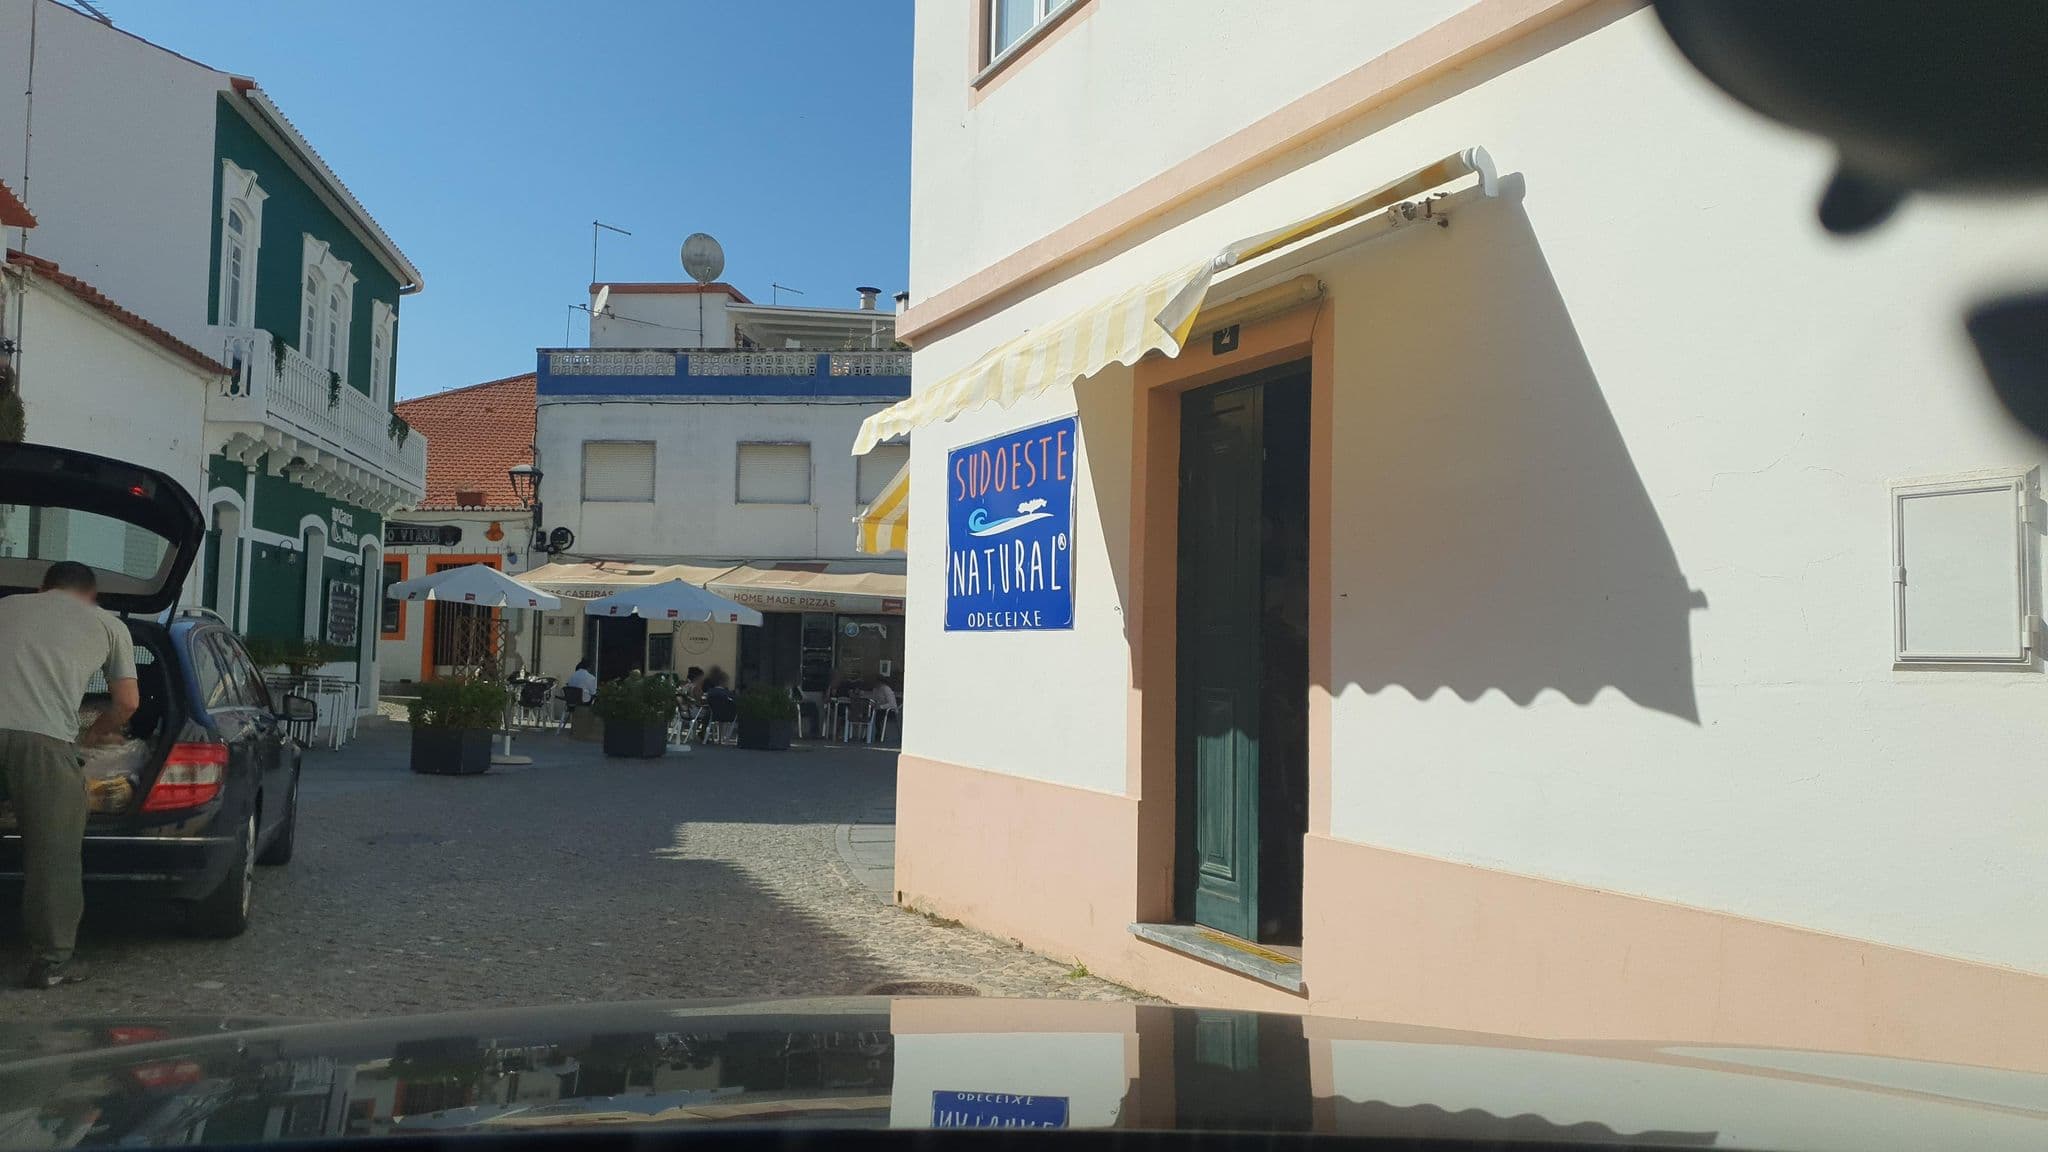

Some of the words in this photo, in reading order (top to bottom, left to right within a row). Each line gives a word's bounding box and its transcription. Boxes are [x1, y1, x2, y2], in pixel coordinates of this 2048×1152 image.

[1220, 327, 1232, 345] 2
[955, 430, 1068, 502] SUDOESTE
[565, 590, 615, 599] CASEIRAS
[733, 593, 763, 603] HOME
[767, 596, 796, 605] MADE
[800, 597, 837, 608] PIZZAS
[967, 610, 1042, 628] ODECEIXE
